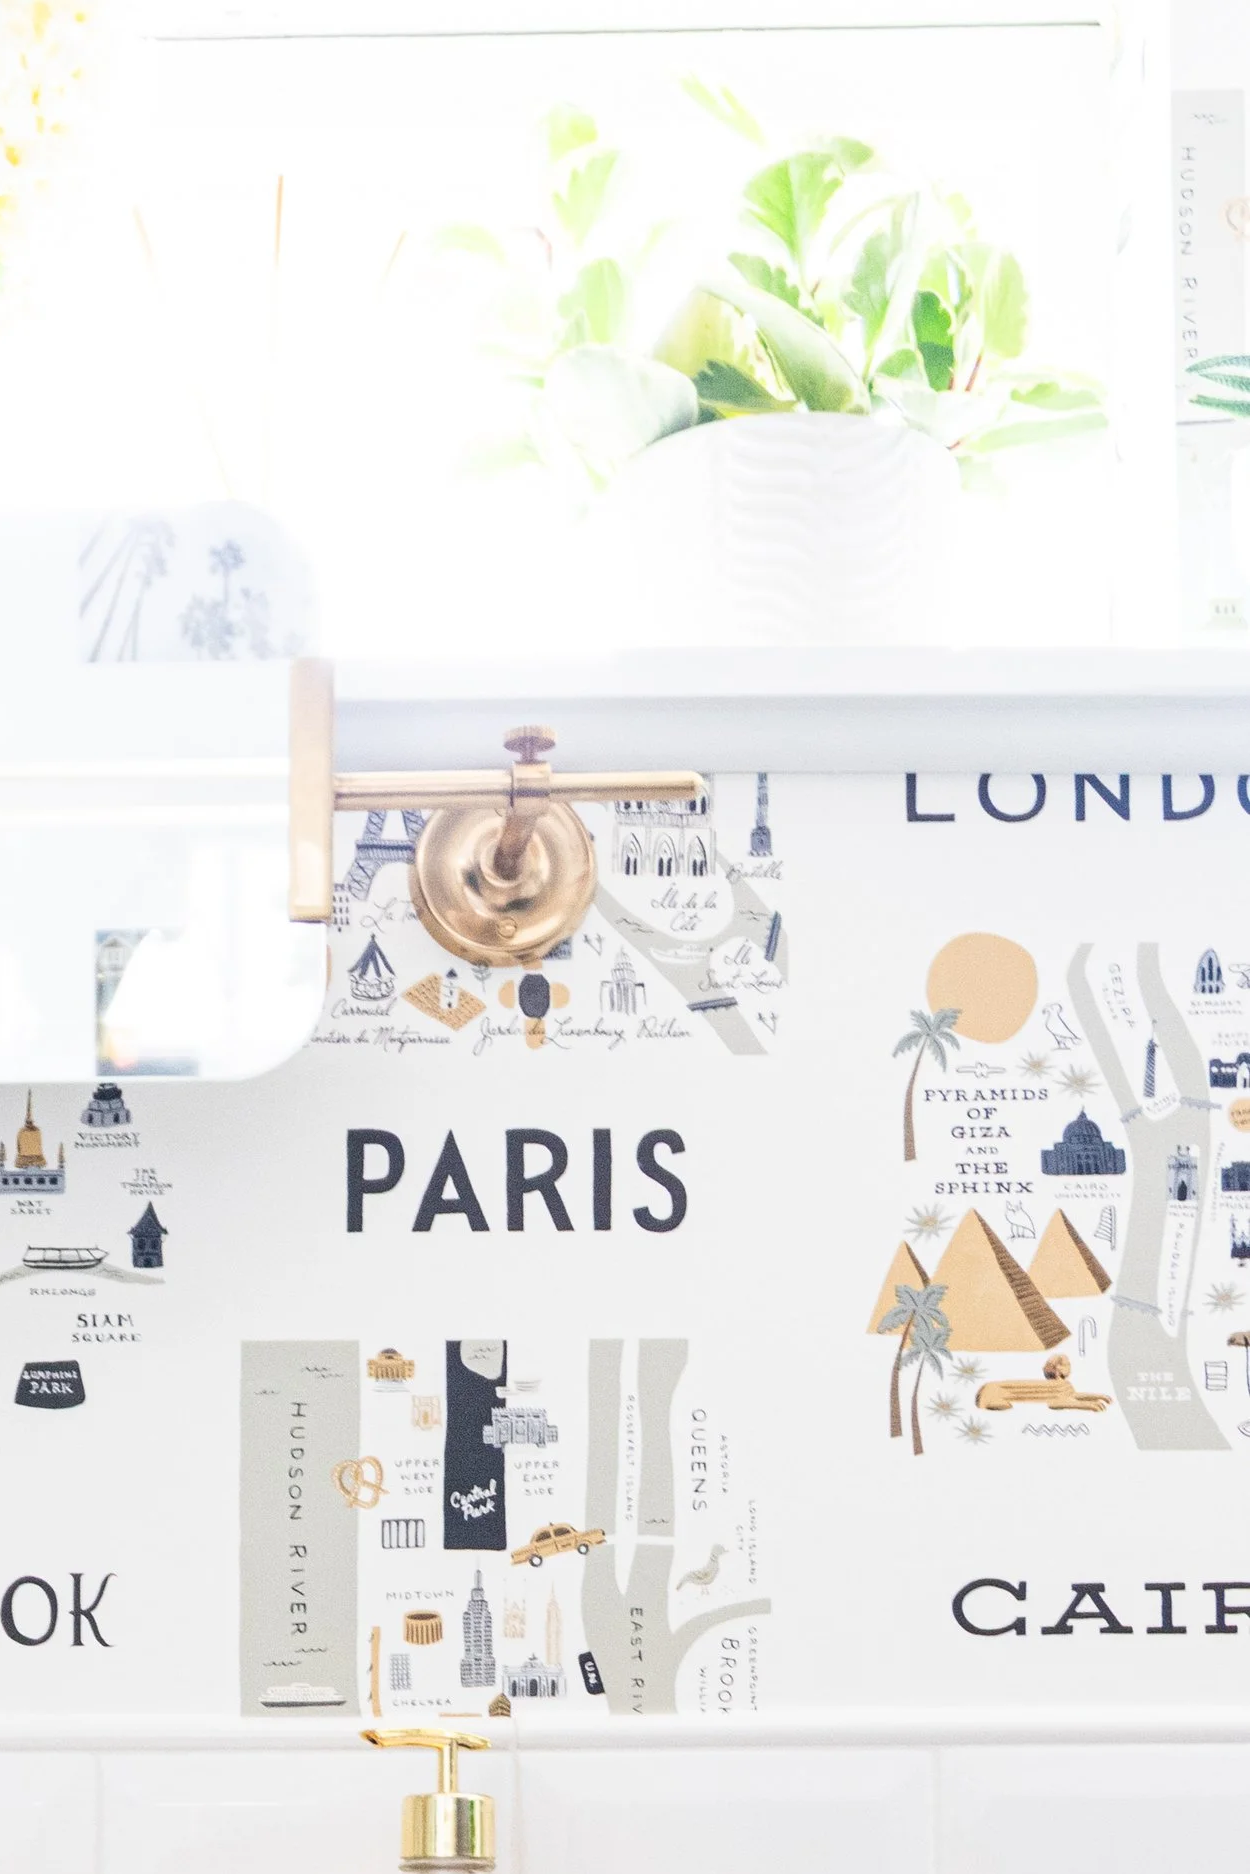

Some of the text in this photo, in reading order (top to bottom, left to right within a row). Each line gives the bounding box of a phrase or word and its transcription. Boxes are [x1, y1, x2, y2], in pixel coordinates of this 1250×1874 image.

[1179, 145, 1198, 360] HUDSON RIVER
[905, 773, 1250, 823] LOND
[702, 890, 718, 909] la
[924, 1088, 1049, 1102] PYRAMIDS
[966, 1107, 998, 1120] OF
[77, 1132, 141, 1141] VICTORY
[951, 1125, 1012, 1138] GIZA
[964, 1147, 999, 1155] AND
[955, 1162, 1009, 1174] THE
[347, 1127, 688, 1233] PARIS
[934, 1181, 1035, 1194] SPHINX
[76, 1313, 135, 1329] SIAM
[71, 1332, 143, 1344] SQUARE
[1136, 1371, 1175, 1382] THE
[28, 1381, 74, 1394] PARK
[1126, 1385, 1192, 1402] NILE
[394, 1459, 441, 1469] UPPER
[514, 1460, 560, 1470] UPPER
[691, 1407, 709, 1512] QUEENS
[400, 1473, 435, 1481] WEST
[523, 1474, 556, 1482] EAST
[404, 1487, 434, 1495] SIDE
[450, 1479, 498, 1509] Central
[524, 1487, 555, 1496] SIDE
[461, 1500, 496, 1521] Park
[287, 1401, 308, 1636] HUDSON RIVER
[385, 1590, 456, 1600] MIDTOWN
[951, 1578, 1250, 1636] CAIR
[630, 1606, 644, 1662] EAST
[391, 1698, 453, 1707] CHELSEA
